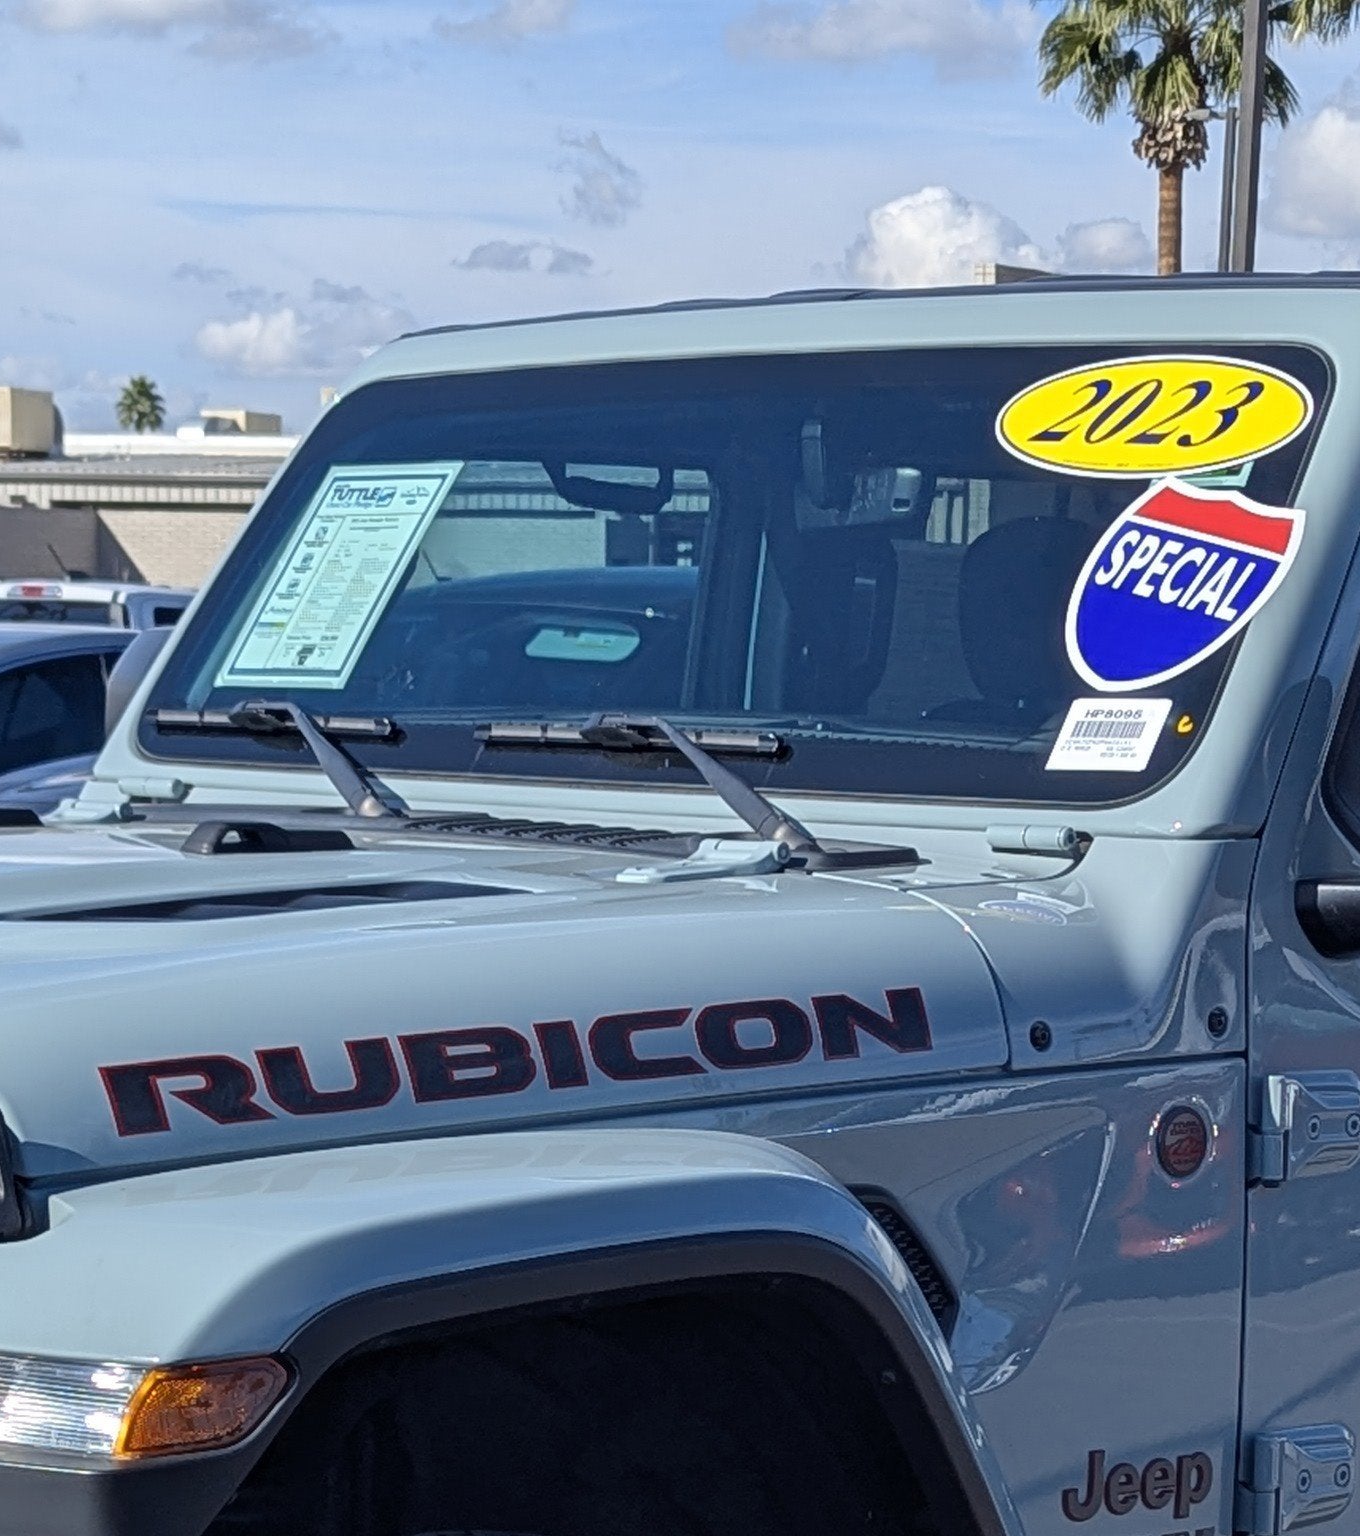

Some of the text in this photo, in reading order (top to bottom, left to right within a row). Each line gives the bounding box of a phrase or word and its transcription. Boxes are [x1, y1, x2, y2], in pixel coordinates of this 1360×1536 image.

[1028, 378, 1265, 447] 2023
[330, 487, 381, 501] TUTTLE
[1094, 529, 1259, 623] SPECIAL
[98, 987, 933, 1138] RUBICON
[1061, 1449, 1213, 1523] Jeep
